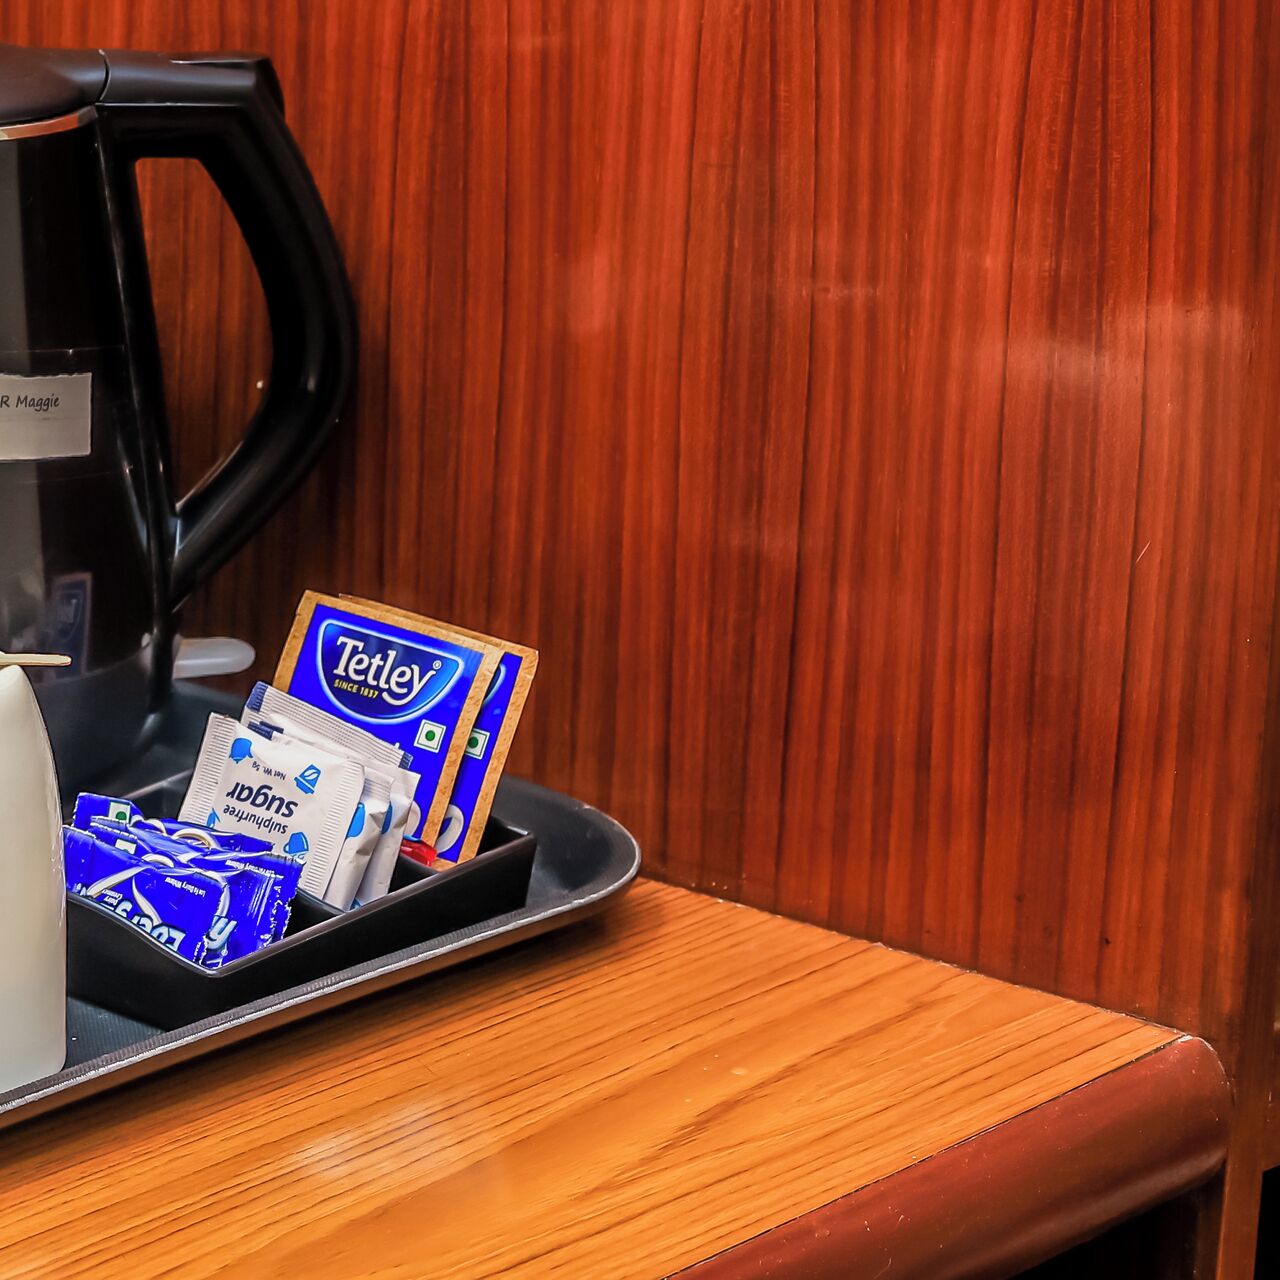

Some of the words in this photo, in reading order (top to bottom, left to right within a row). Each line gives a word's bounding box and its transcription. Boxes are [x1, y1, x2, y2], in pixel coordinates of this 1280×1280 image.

[15, 394, 60, 412] Maggie
[333, 636, 436, 706] Tetley
[333, 679, 358, 694] SINCE
[274, 770, 286, 780] Net
[226, 782, 298, 818] sugar
[223, 804, 288, 834] sulphurfree
